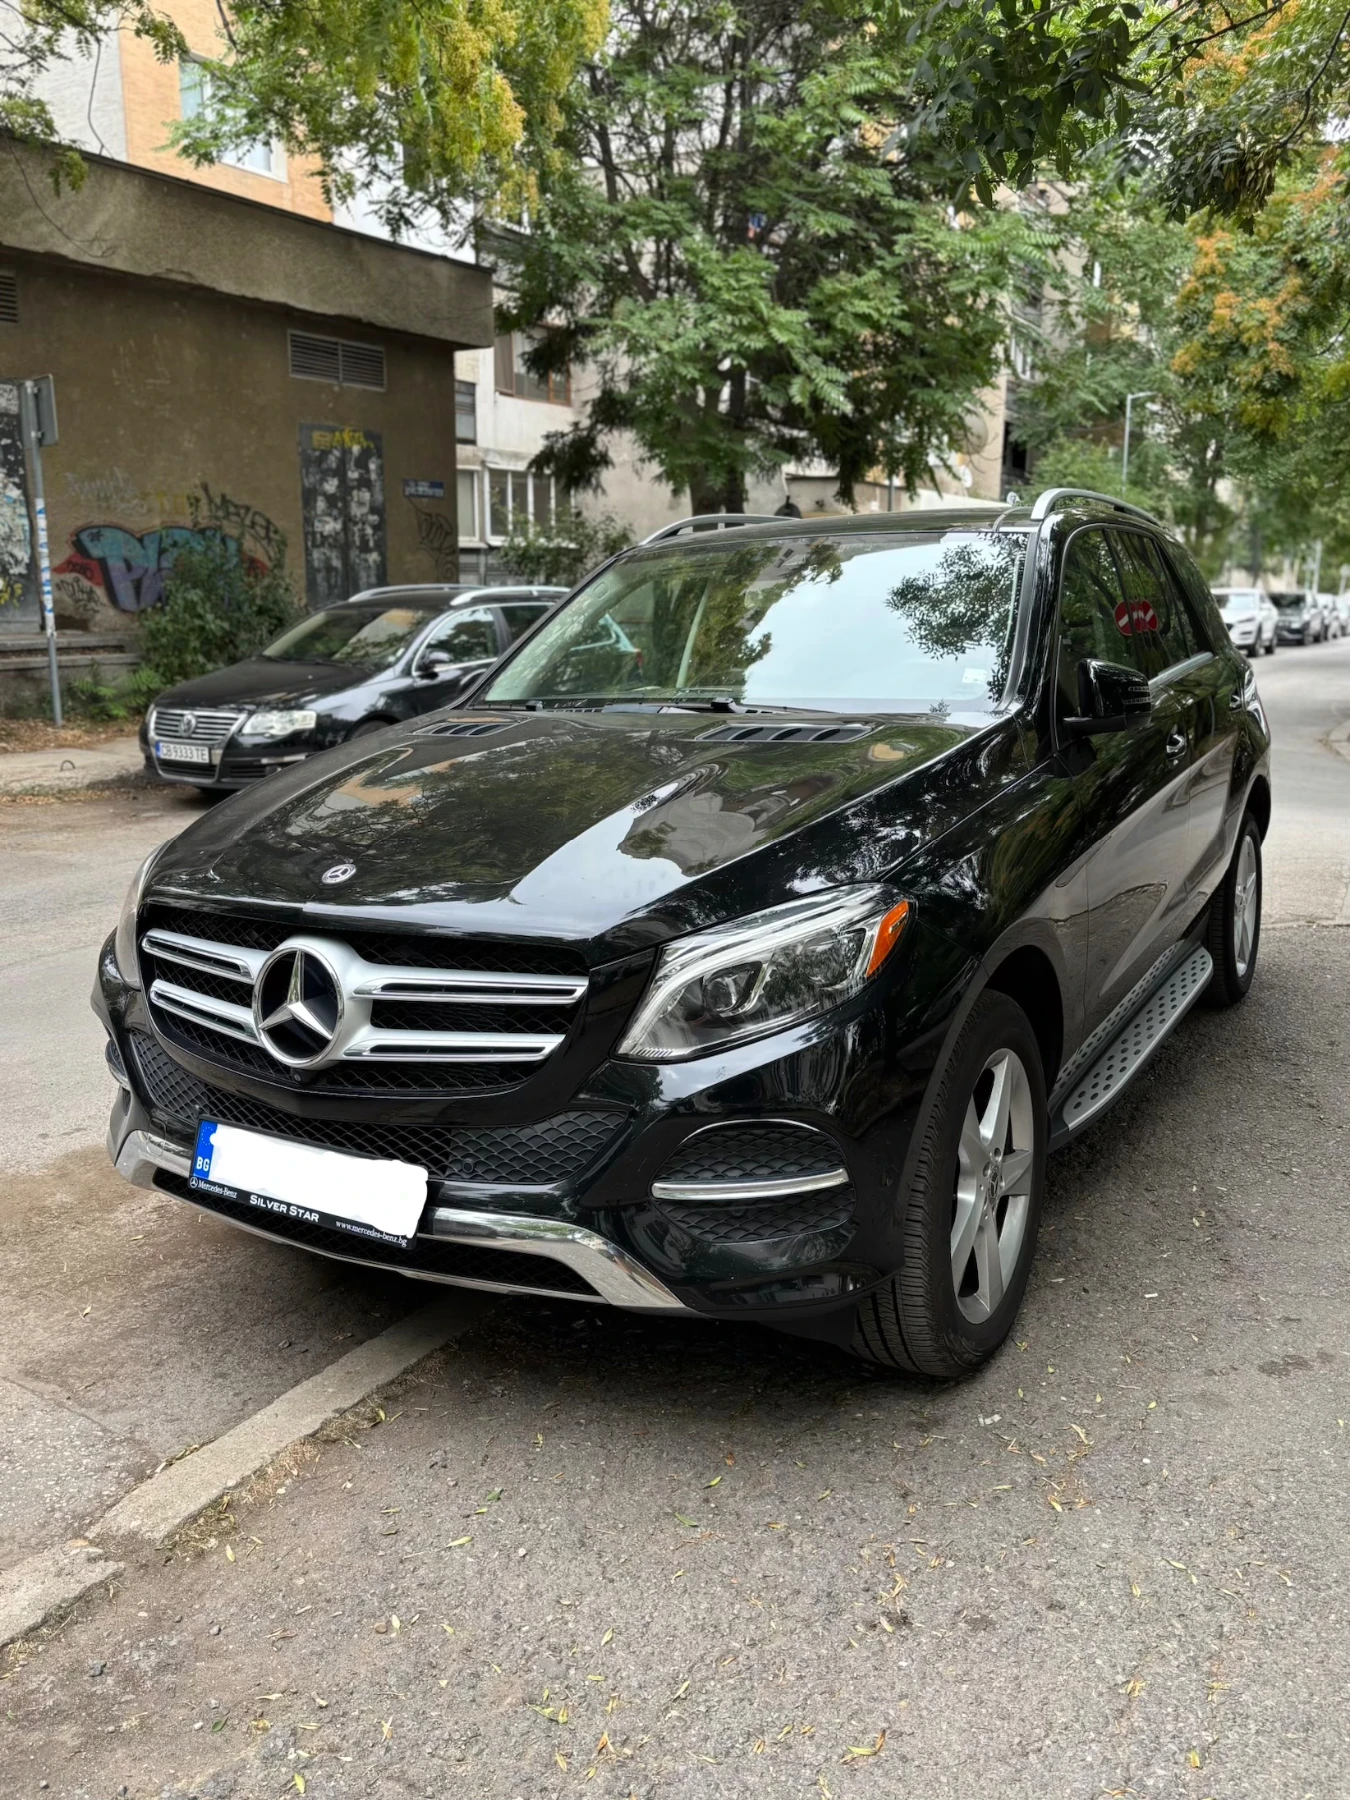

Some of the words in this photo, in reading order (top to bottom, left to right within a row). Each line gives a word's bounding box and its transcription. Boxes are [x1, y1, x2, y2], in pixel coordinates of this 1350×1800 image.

[173, 745, 194, 759] 9333
[195, 748, 207, 761] TE
[196, 1156, 210, 1172] BG
[198, 1180, 238, 1198] Mercedes-Benz
[249, 1194, 287, 1214] SILVER
[289, 1205, 320, 1222] STAR
[335, 1220, 408, 1247] www.mercedes-benz.bg
